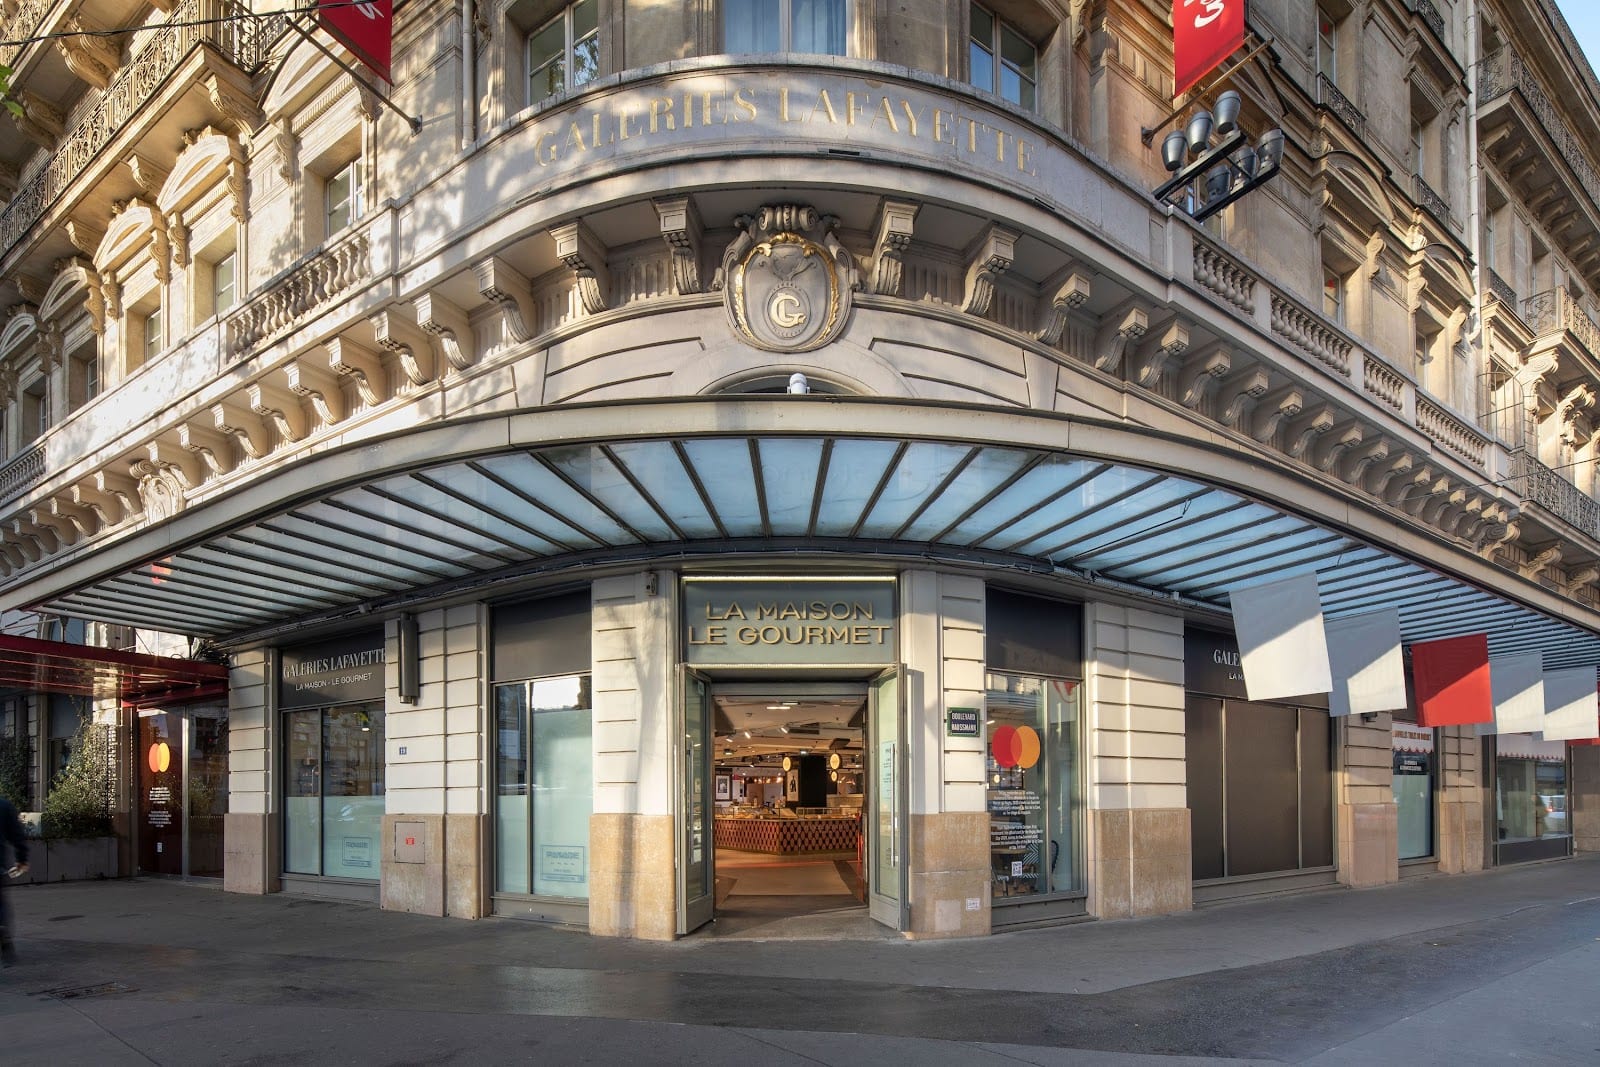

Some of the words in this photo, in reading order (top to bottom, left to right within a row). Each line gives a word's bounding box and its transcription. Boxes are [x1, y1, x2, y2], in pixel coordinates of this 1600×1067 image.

[534, 87, 757, 167] GALERIES
[780, 87, 1037, 177] LAFAYETTE
[706, 601, 747, 620] LA
[755, 601, 873, 620] MAISON
[688, 625, 727, 644] LE
[736, 625, 890, 644] GOURMET
[283, 658, 329, 679] GALERIES
[295, 683, 304, 691] LA
[304, 679, 327, 689] MAISON
[331, 677, 340, 686] LE
[340, 672, 373, 684] GOURMET
